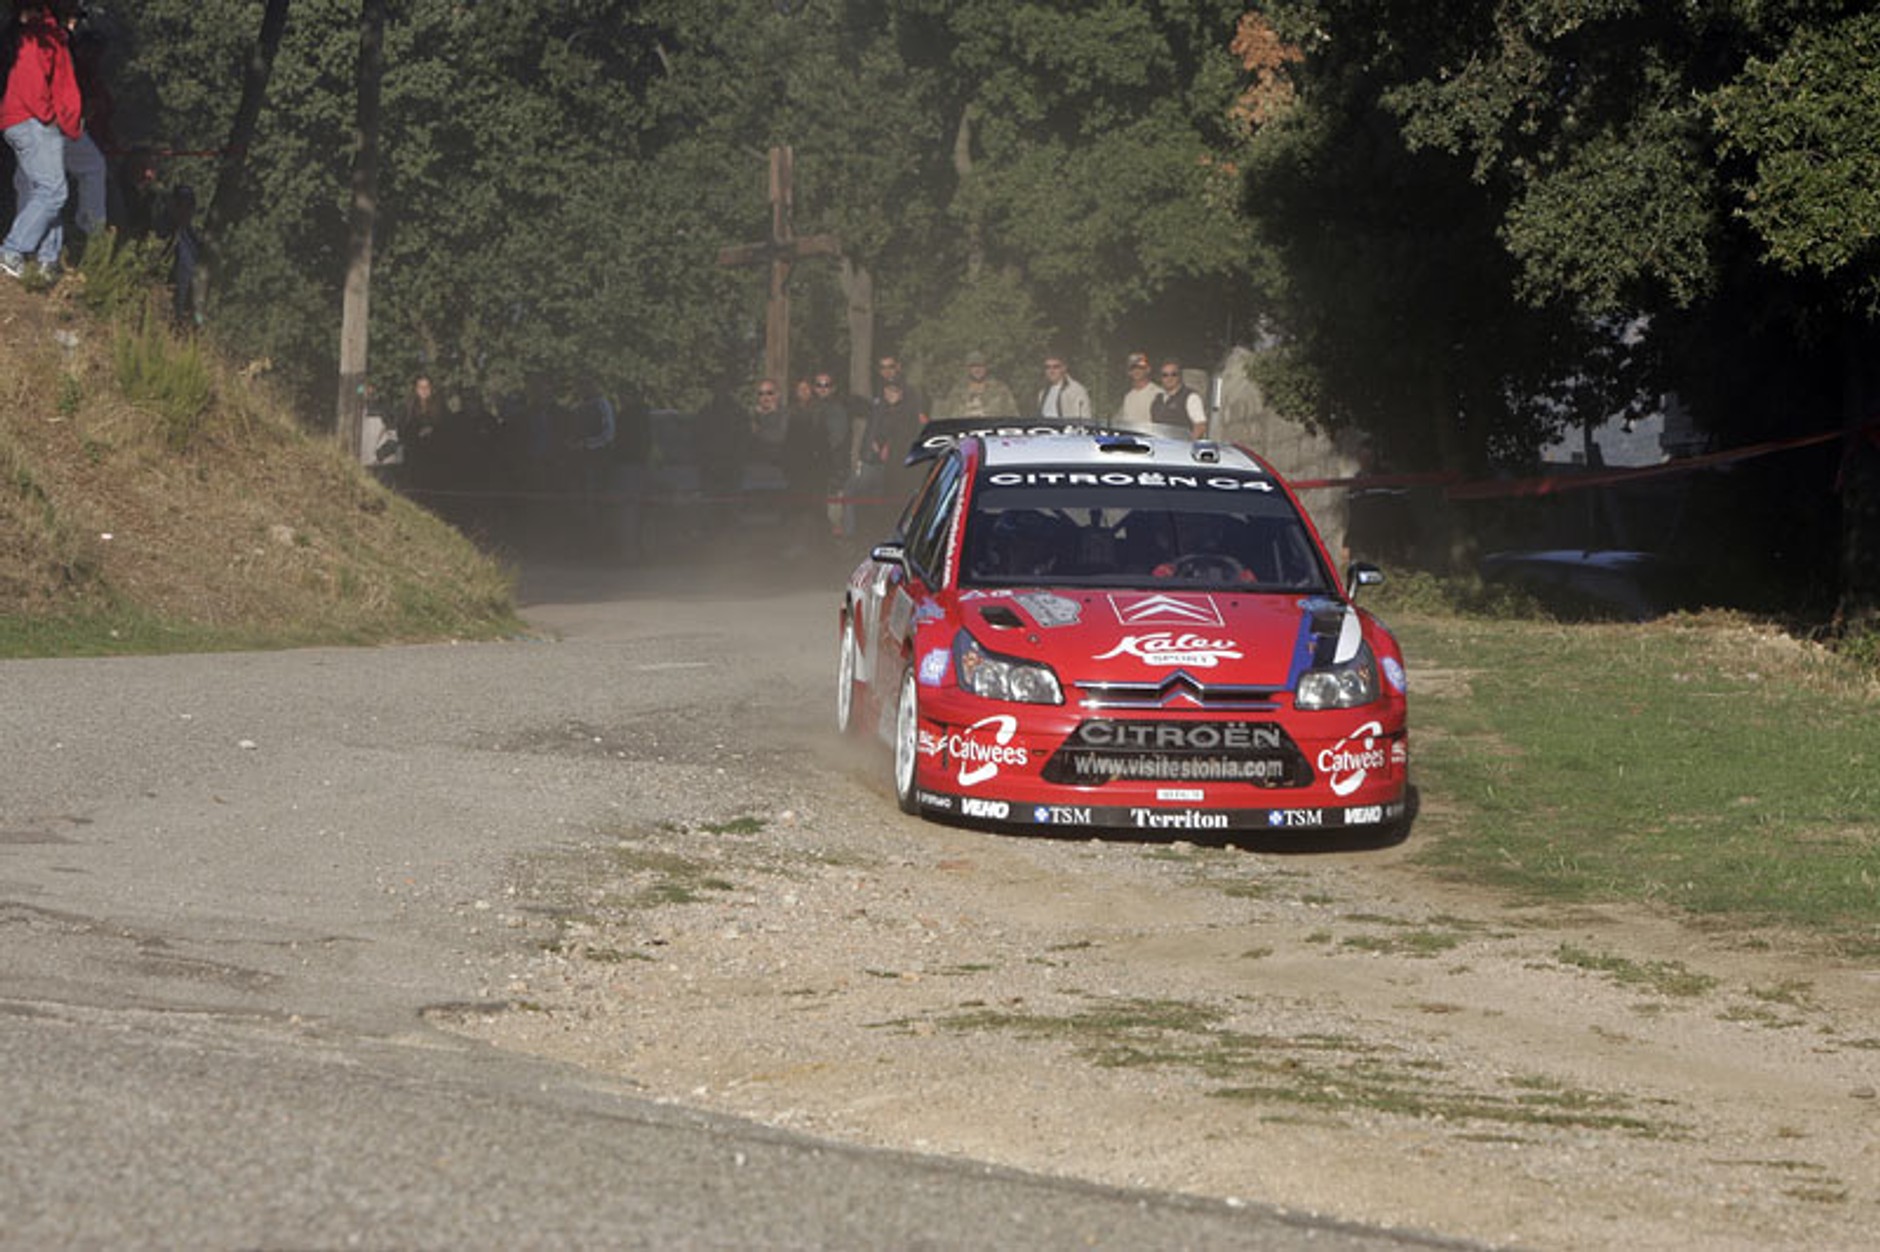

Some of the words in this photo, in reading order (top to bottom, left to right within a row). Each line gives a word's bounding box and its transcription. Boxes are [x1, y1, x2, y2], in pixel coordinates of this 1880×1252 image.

[1207, 478, 1275, 492] C4
[1091, 631, 1244, 660] Kalev
[1079, 722, 1281, 748] CITROËN
[949, 734, 1028, 766] Catwees
[1317, 749, 1384, 772] Catwees
[1074, 753, 1283, 779] www.visitestonia.com
[1049, 806, 1092, 825] TSM
[1130, 807, 1229, 829] Territon
[1283, 808, 1323, 826] TSM
